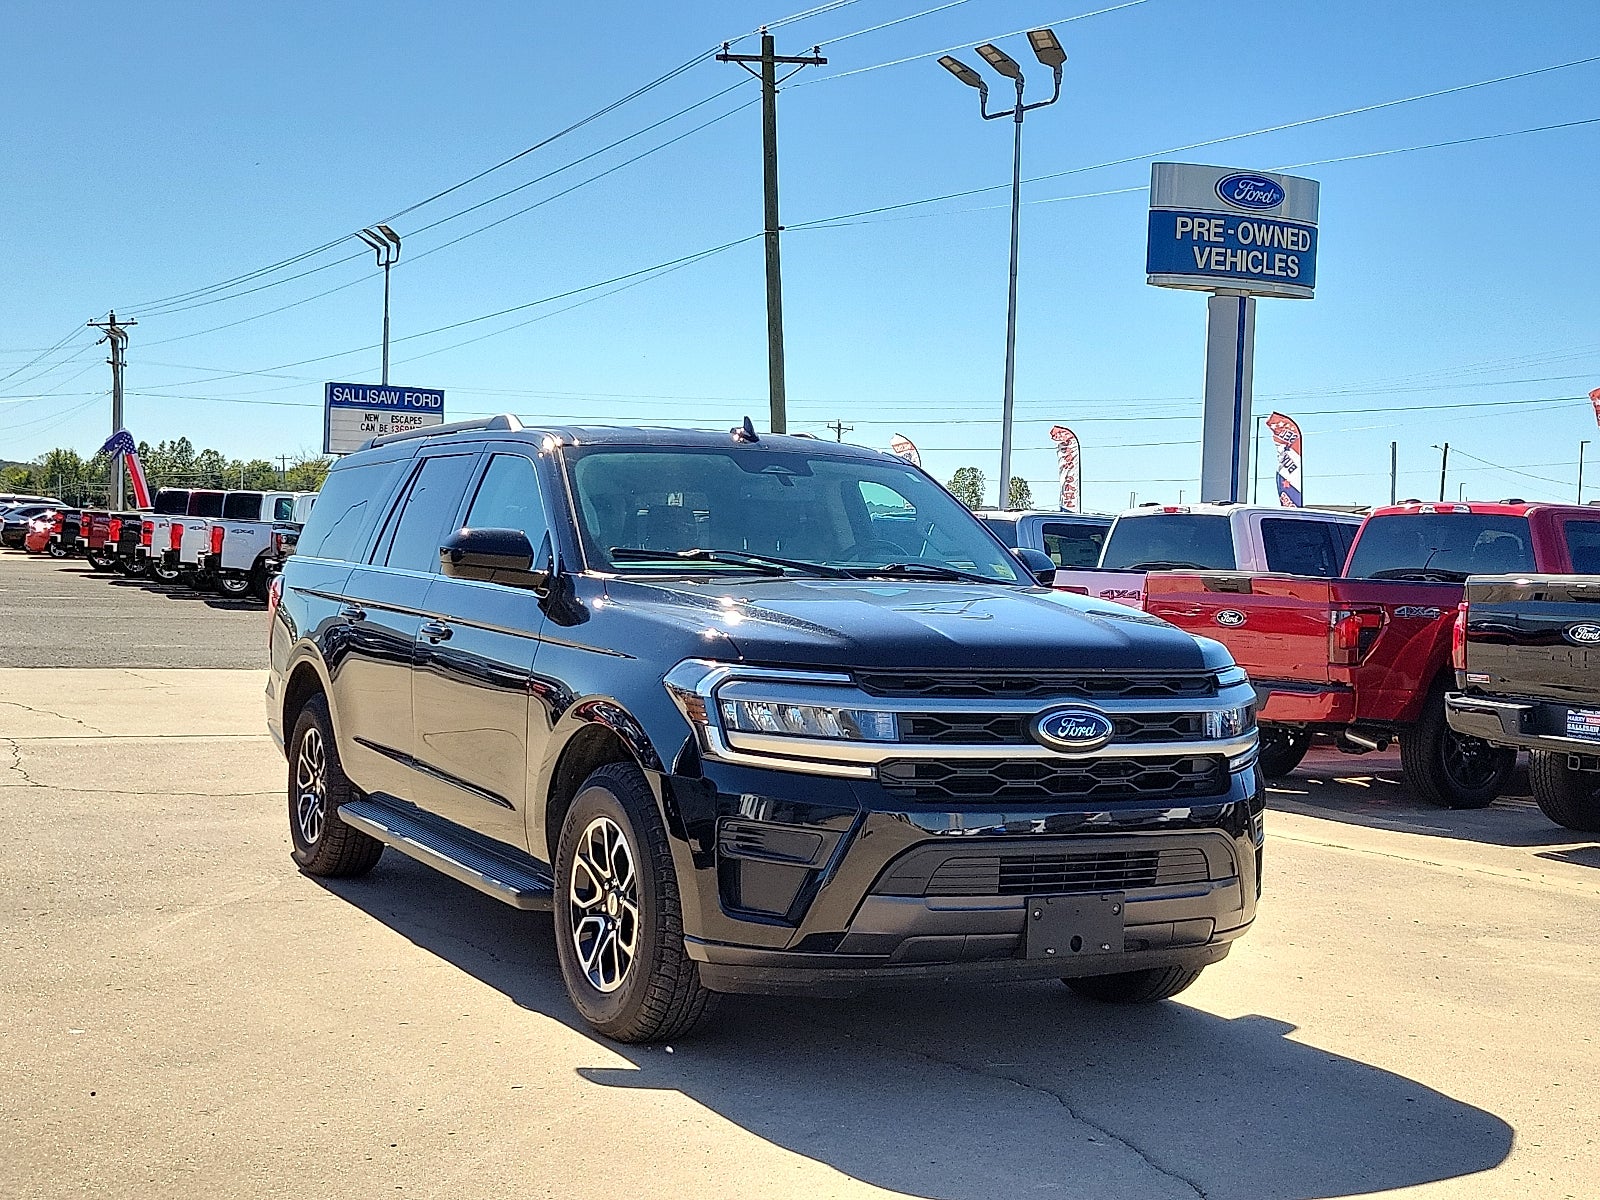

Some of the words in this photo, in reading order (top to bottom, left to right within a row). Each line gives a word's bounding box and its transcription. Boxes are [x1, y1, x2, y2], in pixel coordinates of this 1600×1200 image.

[1234, 180, 1274, 203] Ford
[1193, 246, 1299, 278] VEHICLES
[333, 387, 399, 405] SALLISAW
[404, 392, 441, 408] FORD
[364, 413, 379, 422] NEW
[391, 415, 422, 425] ESCAPES
[360, 423, 375, 432] CAN
[379, 424, 388, 433] BE
[1220, 611, 1239, 623] Ford
[1575, 626, 1600, 640] Ford
[1058, 718, 1096, 737] Ford
